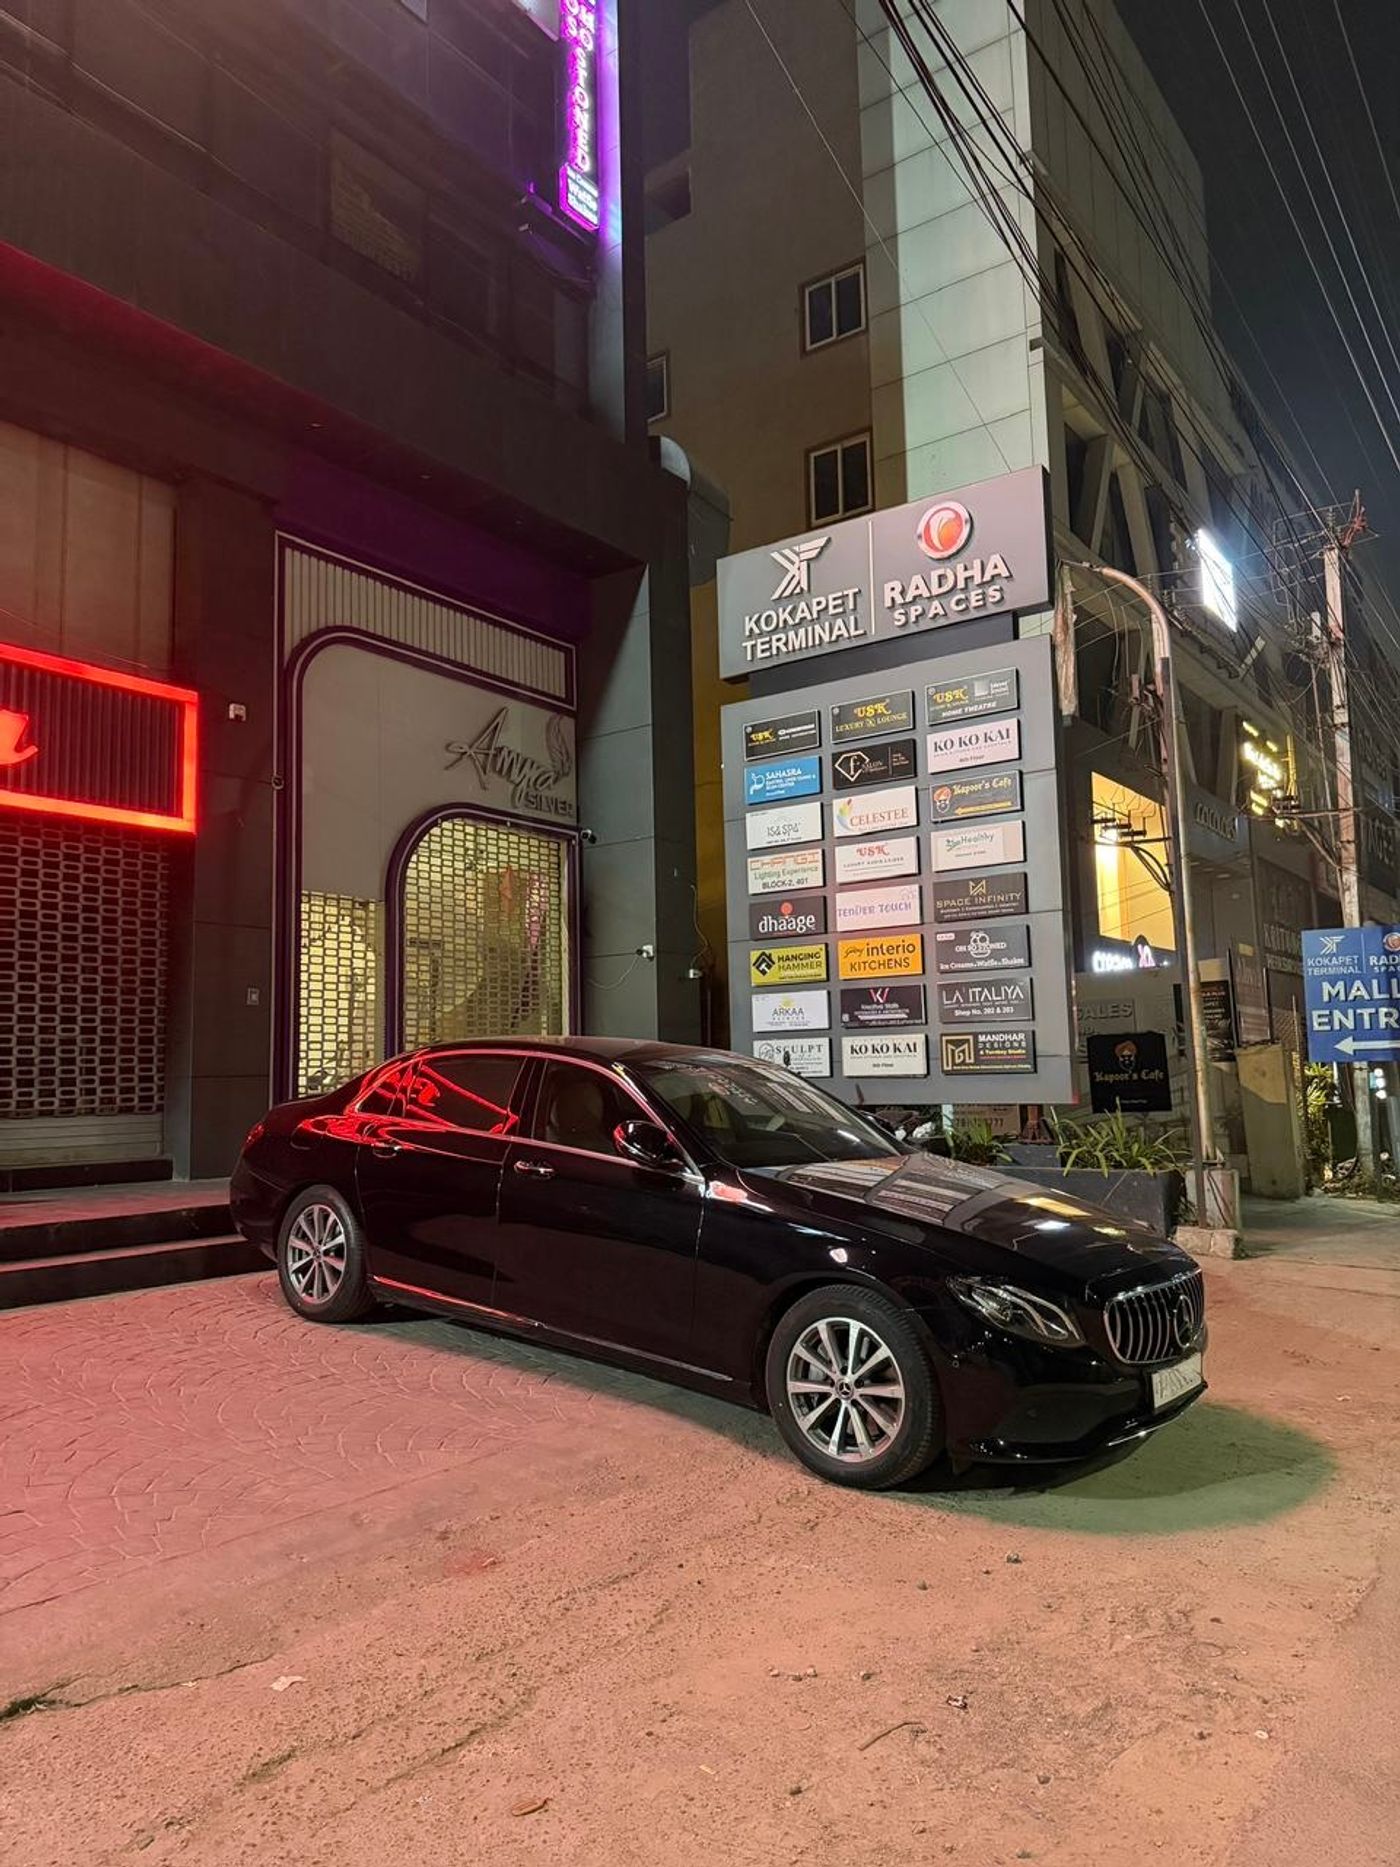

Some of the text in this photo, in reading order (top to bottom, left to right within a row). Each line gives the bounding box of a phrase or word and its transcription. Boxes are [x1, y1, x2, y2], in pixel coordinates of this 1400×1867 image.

[883, 553, 1012, 608] RADHA
[743, 588, 861, 637] KOKAPET
[893, 587, 1005, 628] SPACES
[742, 615, 867, 661] TERMINAL
[934, 737, 955, 753] KO
[959, 732, 981, 748] KO
[984, 727, 1011, 743] KAI
[849, 807, 910, 827] CELESTEE
[936, 891, 1022, 909] SPACE INFINITY
[758, 914, 815, 934] dhaage
[866, 940, 916, 957] interio
[777, 951, 821, 964] HANGING
[850, 958, 911, 973] KITCHENS
[1307, 955, 1360, 967] KOKAPET
[1369, 955, 1400, 966] RAD
[778, 961, 823, 972] HAMMER
[1307, 965, 1362, 976] TERMINAL
[969, 985, 1024, 1002] ITALIYA
[1321, 978, 1400, 1003] MALL
[771, 1007, 805, 1017] ARKAA
[977, 1033, 1026, 1043] MANDHAR
[977, 1041, 1027, 1049] DESIGNS
[775, 1044, 824, 1055] SCULPT
[850, 1041, 918, 1056] KO KO KAI
